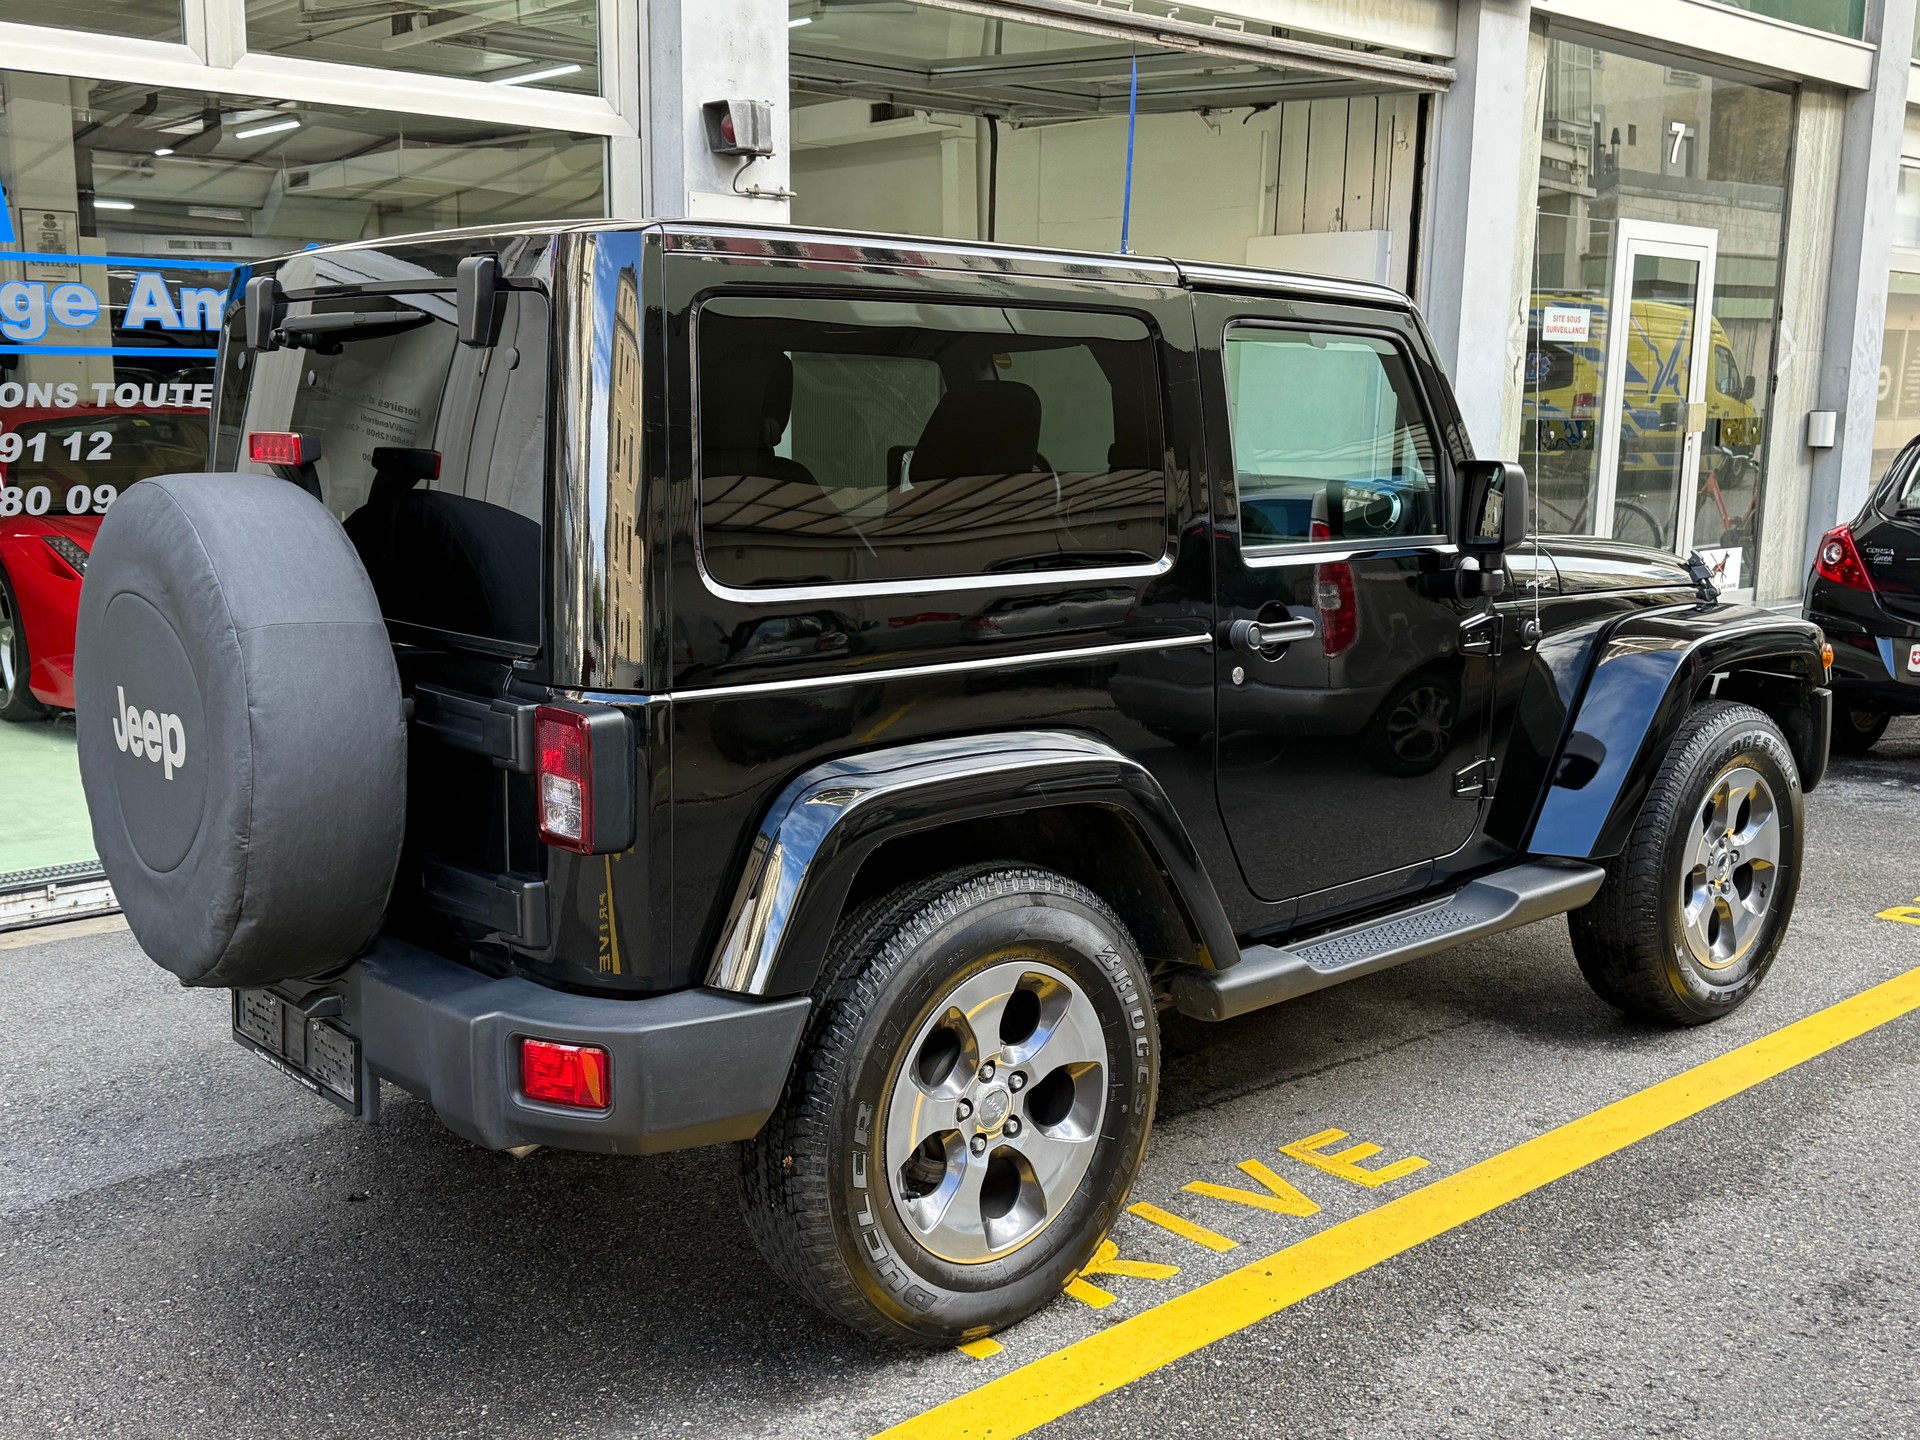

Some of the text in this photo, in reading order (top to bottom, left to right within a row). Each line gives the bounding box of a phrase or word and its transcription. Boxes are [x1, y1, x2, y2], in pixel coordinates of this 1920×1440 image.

[1671, 121, 1686, 164] 7
[1546, 325, 1586, 334] SURVEILLANCE
[1553, 314, 1581, 324] SITE SOUS
[63, 431, 113, 461] 12
[0, 484, 118, 517] 80 09
[112, 685, 186, 781] Jeep
[851, 1100, 939, 1313] DUELER
